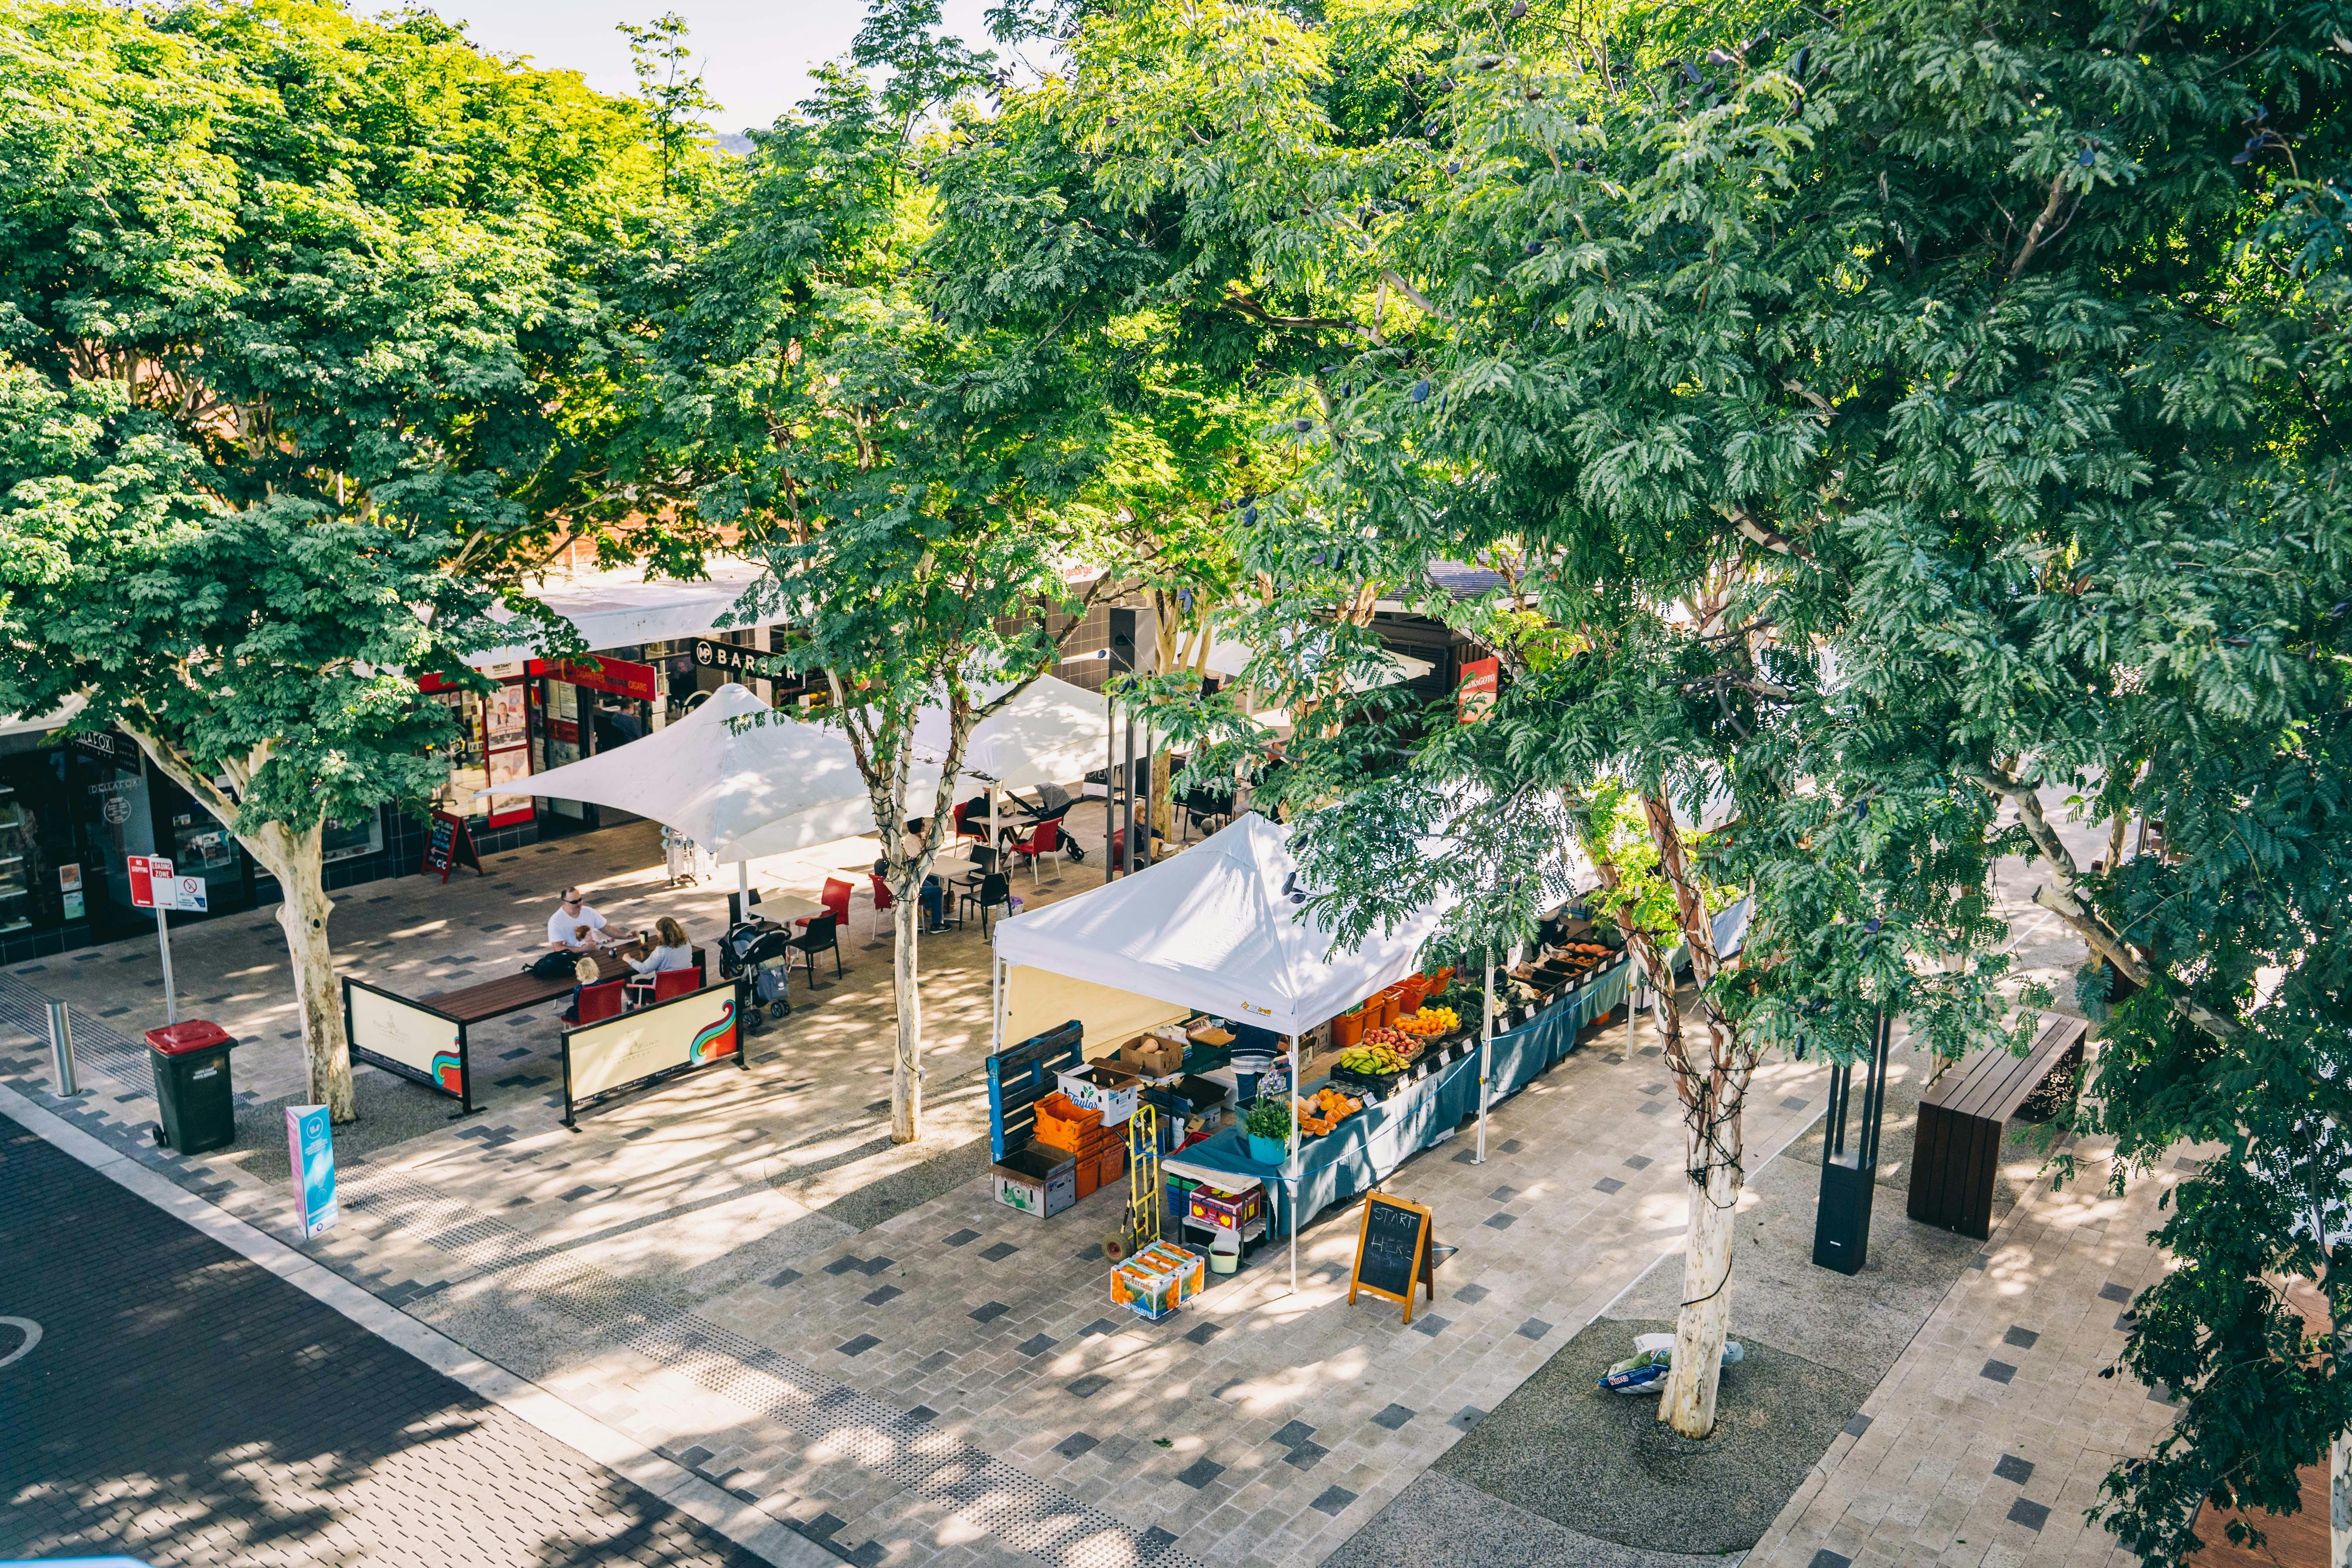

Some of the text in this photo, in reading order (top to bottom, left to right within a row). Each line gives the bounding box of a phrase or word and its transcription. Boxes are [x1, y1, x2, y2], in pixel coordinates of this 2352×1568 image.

[718, 649, 796, 680] BARBR
[152, 862, 171, 871] LOADING
[155, 870, 170, 878] ZONE
[1068, 1091, 1099, 1110] Taylor
[1374, 1207, 1417, 1229] START
[1371, 1233, 1413, 1261] HERE
[1123, 1301, 1153, 1318] MANDARINS
[1609, 1375, 1629, 1385] Norco
